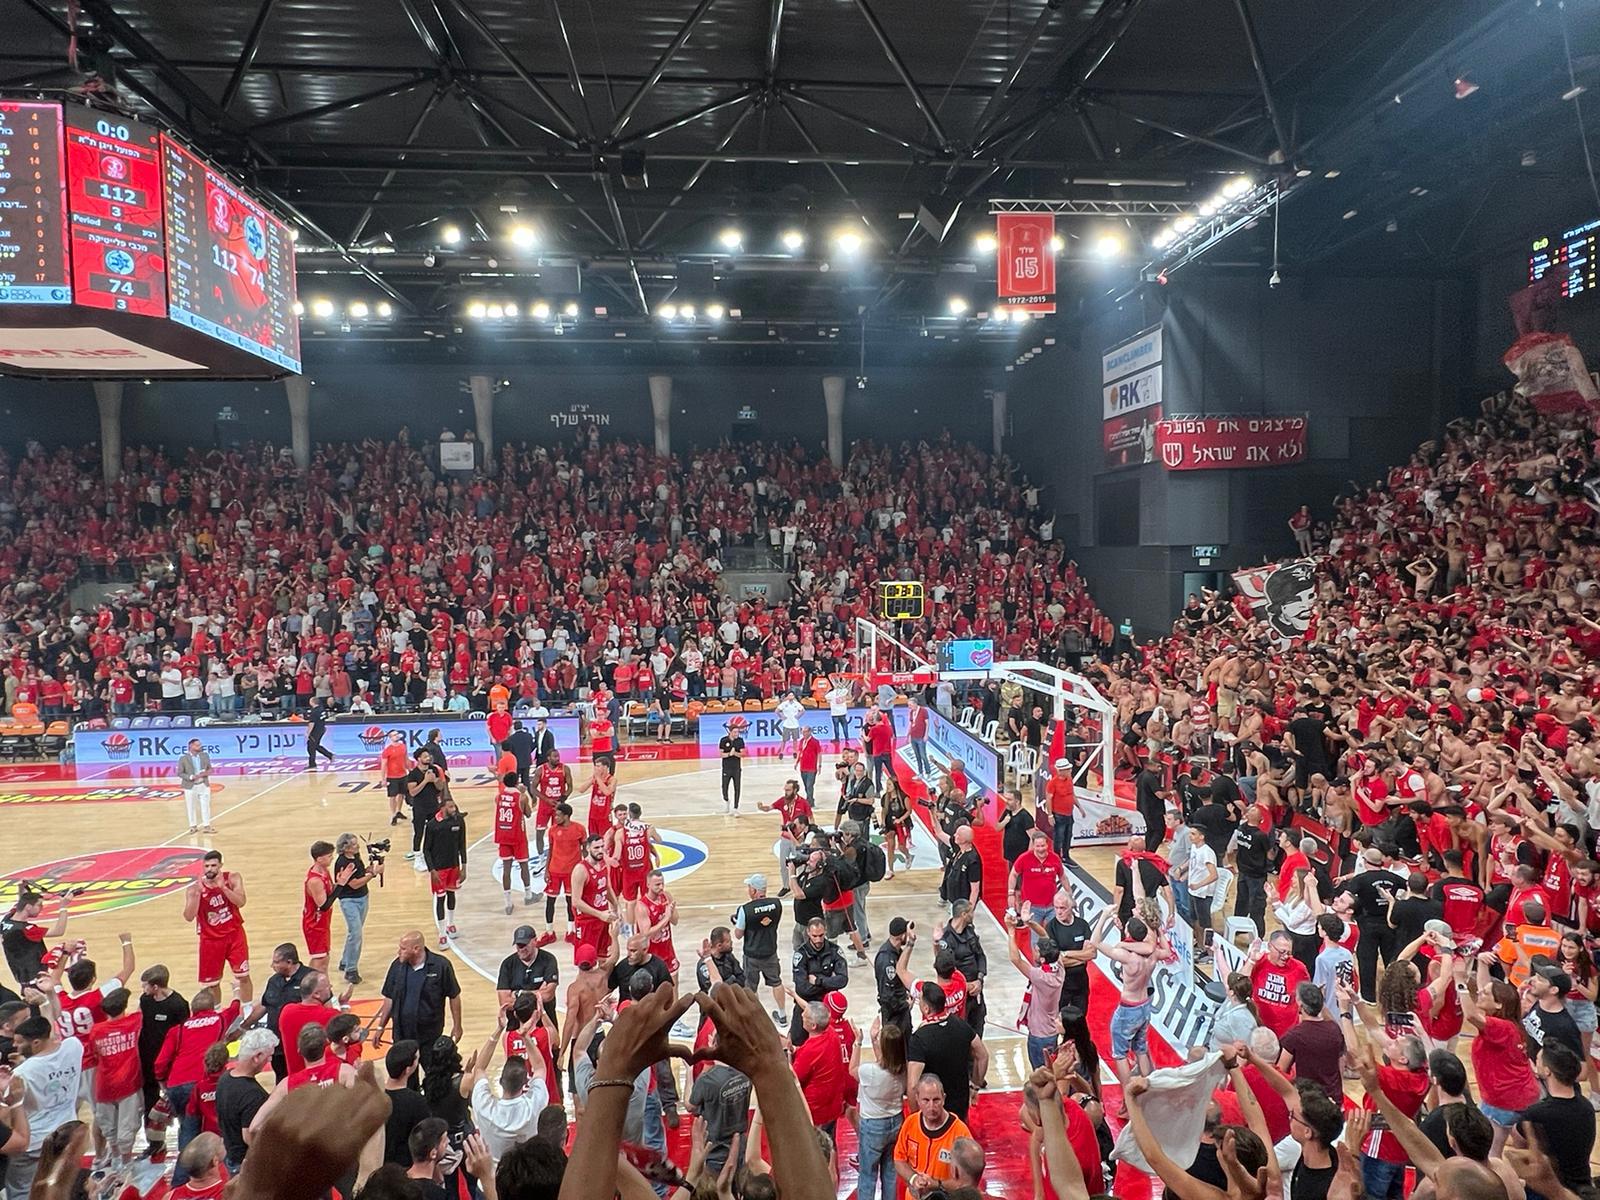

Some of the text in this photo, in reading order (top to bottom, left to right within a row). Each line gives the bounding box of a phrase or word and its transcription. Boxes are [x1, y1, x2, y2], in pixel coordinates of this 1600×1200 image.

[31, 113, 38, 121] 4
[96, 120, 129, 141] 0:0
[100, 183, 137, 205] 112
[111, 206, 122, 217] 3
[73, 214, 122, 232] Period 4
[128, 242, 148, 252] מכבי
[213, 244, 239, 276] 112
[1015, 257, 1039, 278] 15
[109, 278, 134, 296] 74
[116, 299, 127, 310] 3
[1008, 296, 1047, 304] 1972-2015
[1119, 379, 1141, 409] RK
[550, 412, 610, 428] אורי שלף
[1216, 420, 1240, 434] את
[1191, 438, 1303, 464] ולא את ישראל
[756, 718, 784, 738] RK
[138, 736, 171, 756] RK
[235, 734, 260, 753] כץ
[499, 808, 514, 823] 14
[1080, 828, 1095, 837] SIG
[627, 845, 645, 860] 10
[57, 1006, 95, 1038] 99
[95, 1034, 127, 1047] MISSION
